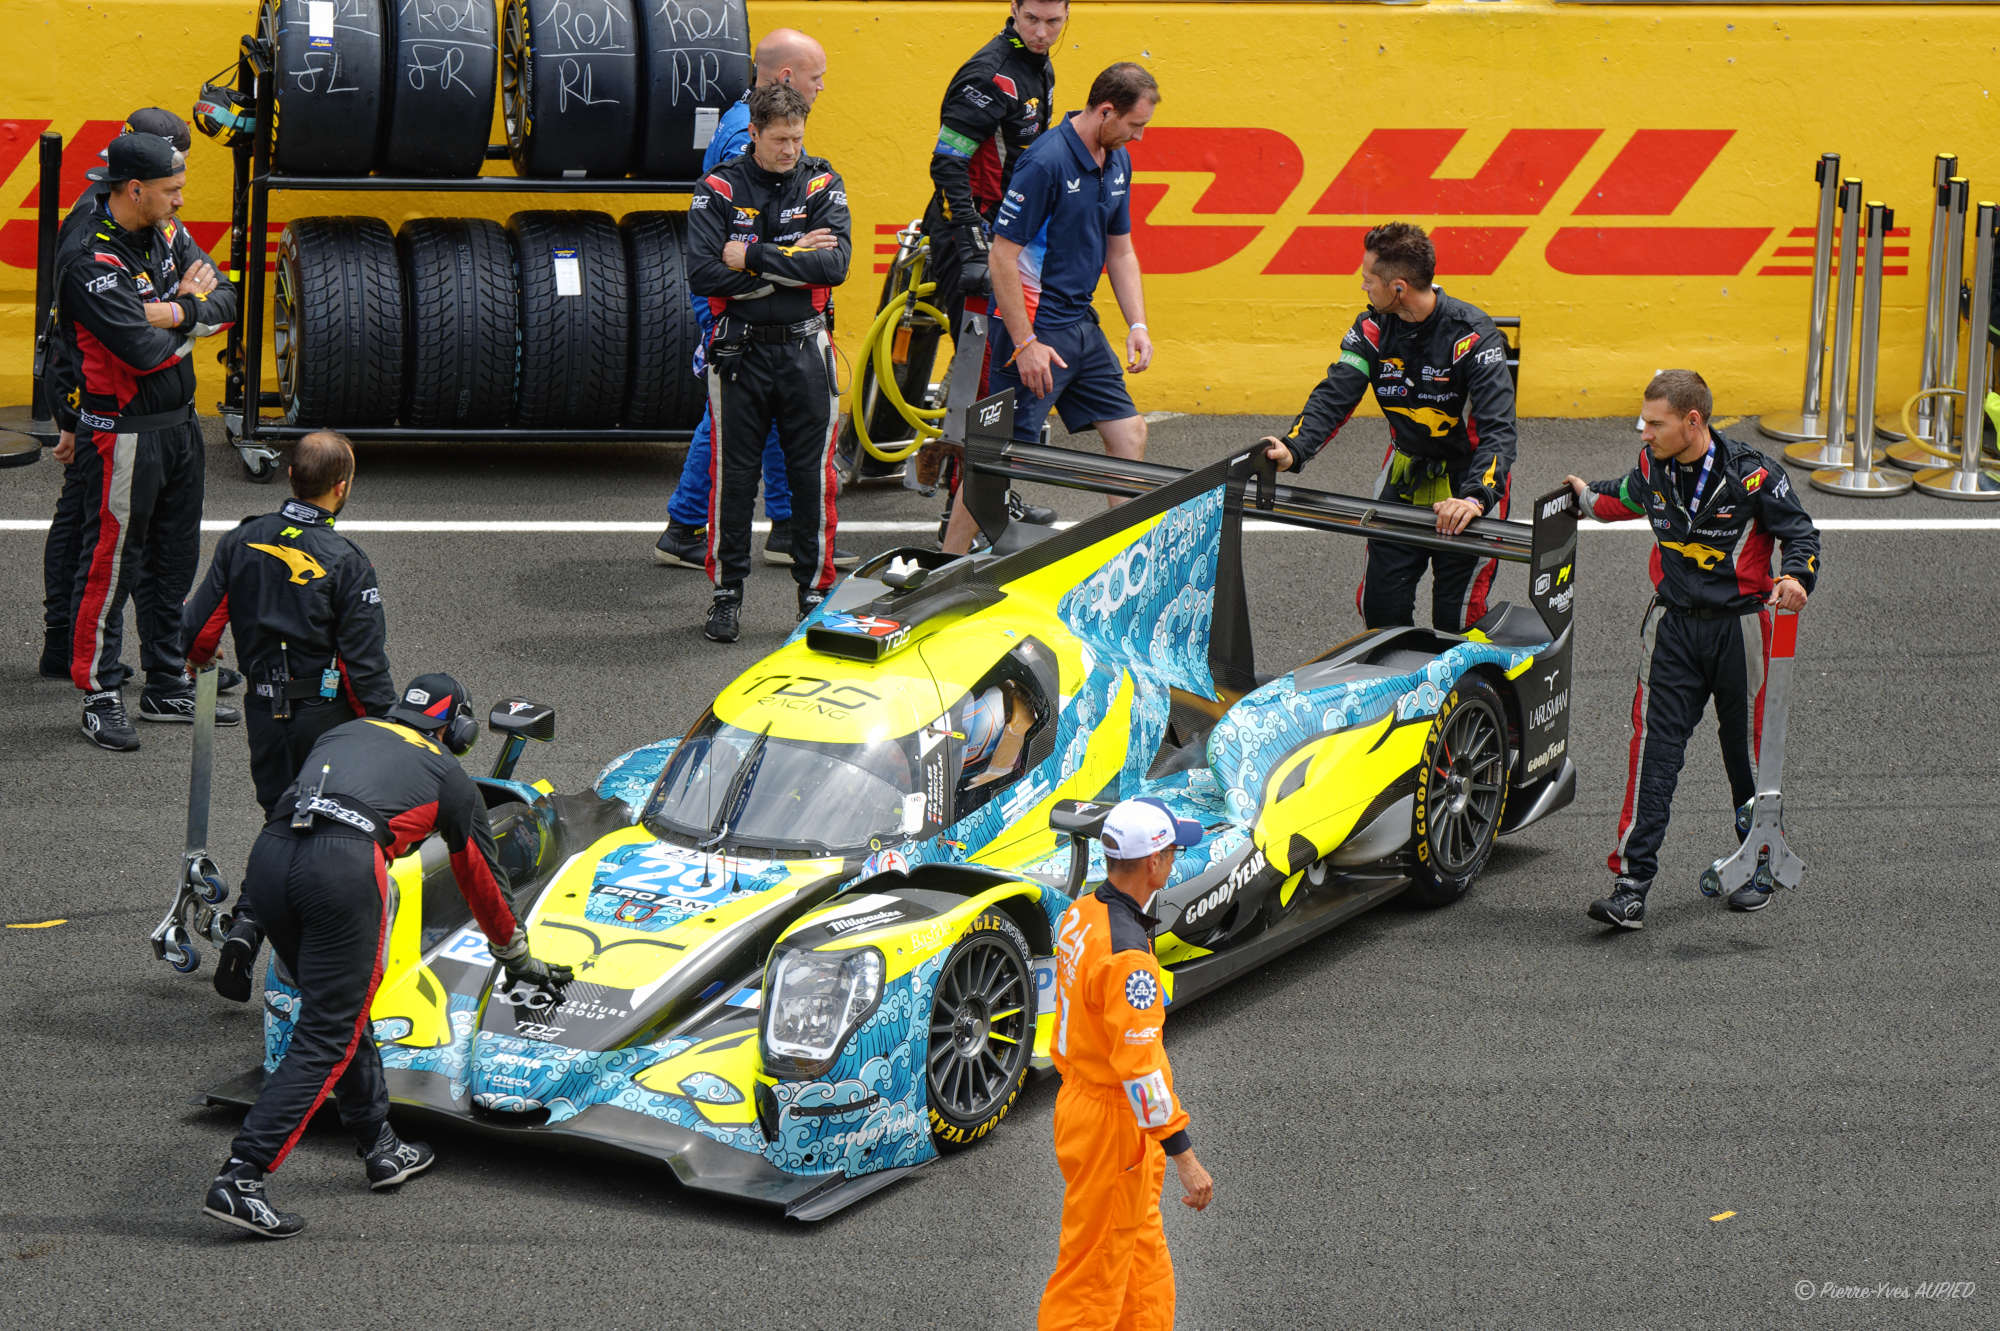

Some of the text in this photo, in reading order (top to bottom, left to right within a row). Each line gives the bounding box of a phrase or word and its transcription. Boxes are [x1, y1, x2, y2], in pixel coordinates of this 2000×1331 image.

[671, 49, 728, 107] RR
[1103, 126, 1776, 275] DHL
[1457, 338, 1472, 357] P1
[1475, 347, 1504, 364] TDS
[1377, 385, 1398, 397] elf
[1745, 473, 1761, 491] P1
[1158, 487, 1226, 549] VENTURE
[1157, 523, 1207, 571] GROUP
[1556, 563, 1572, 586] P1
[885, 626, 913, 653] TDS
[742, 675, 882, 711] TDS
[757, 696, 850, 721] RACING
[1527, 738, 1566, 773] GOODYEAR
[616, 859, 732, 898] 29
[1185, 850, 1267, 925] GOODYEAR
[600, 886, 710, 913] PRO AM
[825, 910, 904, 933] Milwaukee
[556, 1007, 606, 1020] GROUP
[514, 1020, 567, 1037] TDS
[493, 1075, 531, 1089] ORECA
